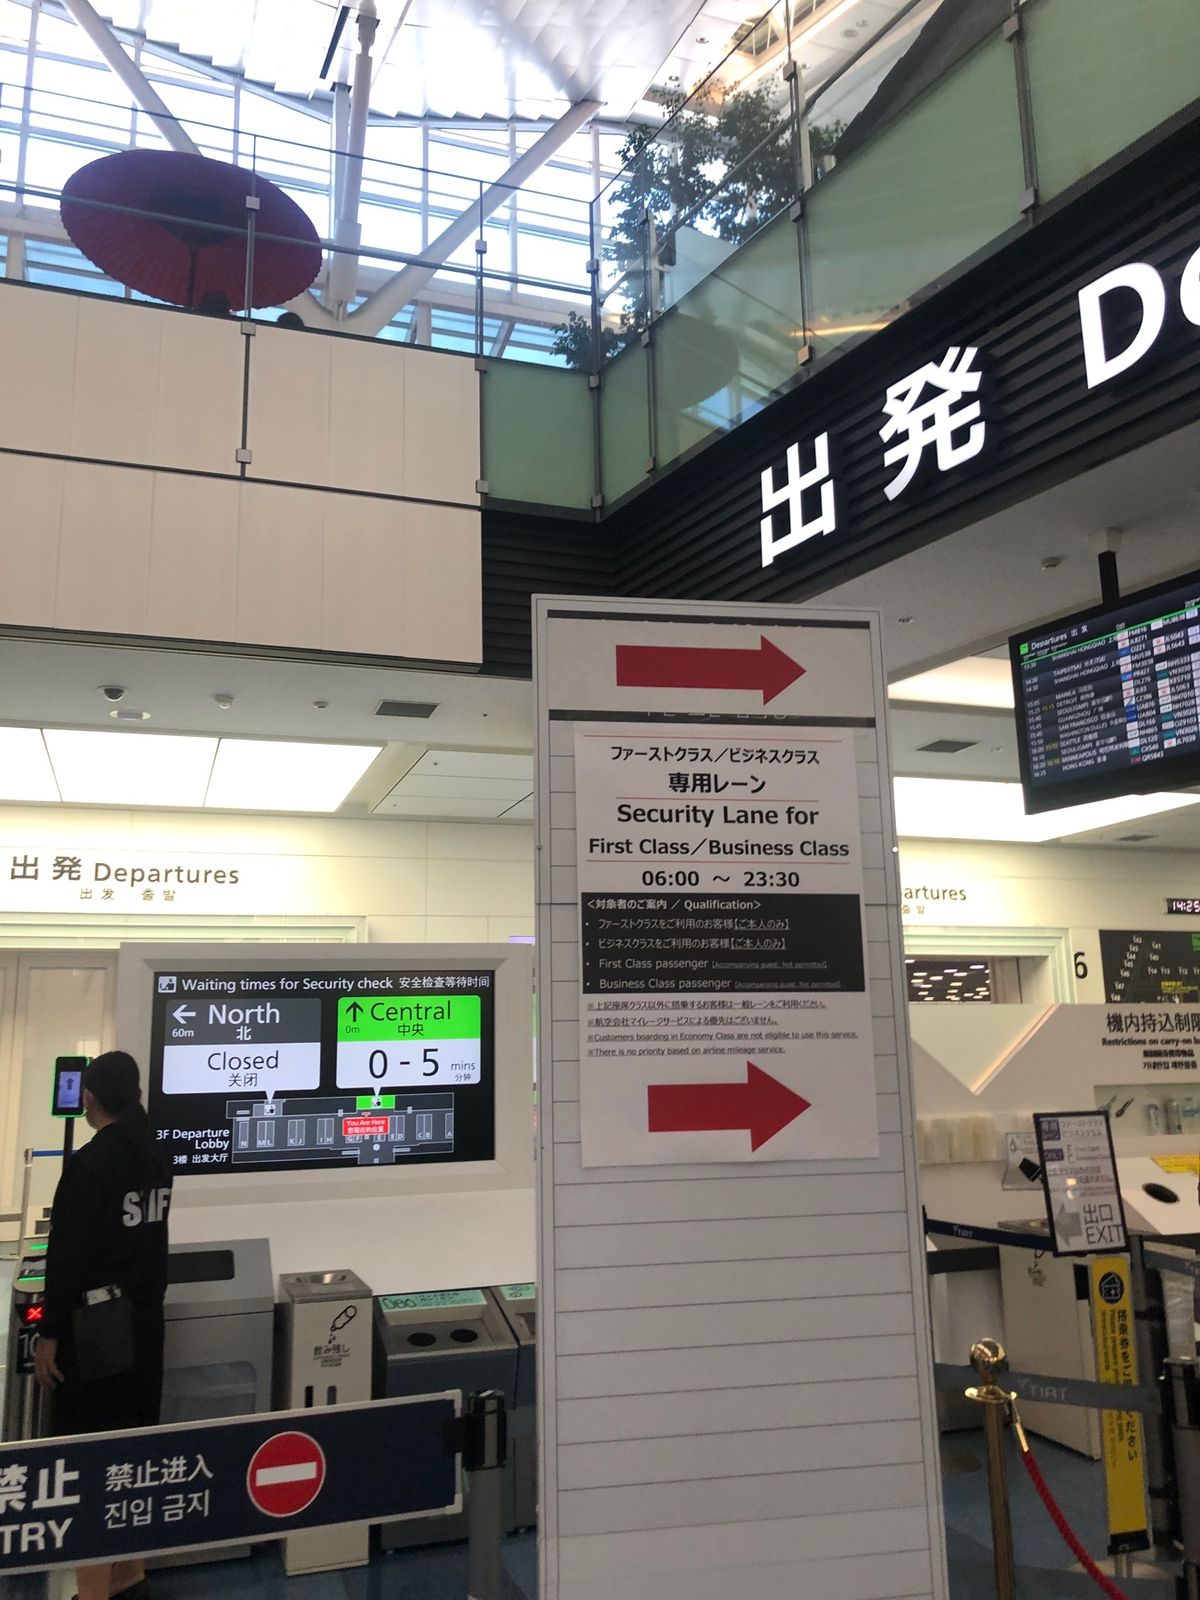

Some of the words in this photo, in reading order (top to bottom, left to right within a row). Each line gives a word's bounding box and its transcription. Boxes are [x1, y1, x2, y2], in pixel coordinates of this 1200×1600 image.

[1078, 245, 1200, 390] D
[760, 347, 986, 568] 出発
[1030, 633, 1067, 649] Departures
[611, 746, 820, 764] ファーストクラス／ビジネスクラス
[668, 772, 766, 793] 専用レーン
[617, 804, 714, 827] Security
[723, 806, 778, 825] Lane
[786, 806, 819, 825] for
[589, 838, 633, 854] First
[800, 841, 849, 856] Class
[10, 855, 82, 881] 出発
[94, 863, 239, 887] Departures
[642, 871, 699, 887] 06:00
[743, 872, 800, 888] 23:30
[599, 959, 622, 969] First
[625, 959, 652, 969] Class
[656, 959, 708, 971] passenger
[182, 979, 236, 993] Waiting
[241, 978, 276, 990] times
[279, 977, 300, 990] for
[303, 977, 354, 991] Security
[358, 976, 393, 989] check
[398, 976, 491, 989] 安全检查等待时间
[599, 979, 645, 989] Business
[648, 979, 676, 988] Class
[679, 979, 731, 990] passenger
[208, 1003, 281, 1026] North
[370, 1000, 452, 1022] Central
[171, 1027, 195, 1039] 60m
[236, 1026, 252, 1041] 北
[345, 1025, 361, 1034] 0m
[397, 1023, 425, 1037] 中央
[636, 1031, 668, 1042] boarding
[671, 1032, 678, 1040] in
[680, 1032, 713, 1041] Economy
[715, 1031, 735, 1039] Class
[765, 1031, 790, 1040] eligible
[816, 1031, 829, 1039] this
[1102, 1037, 1147, 1047] Restrictions
[1161, 1038, 1192, 1048] carry-on
[639, 1047, 664, 1057] priority
[667, 1047, 688, 1055] based
[727, 1046, 756, 1055] mileage
[758, 1046, 785, 1054] service.
[207, 1051, 280, 1071] Closed
[368, 1049, 389, 1079] 0
[421, 1048, 440, 1076] 5
[450, 1060, 476, 1072] mins
[228, 1073, 259, 1087] 关闭
[454, 1072, 473, 1082] 分钟
[360, 1118, 371, 1126] Are
[371, 1118, 386, 1126] Here
[156, 1129, 169, 1140] 3F
[172, 1127, 230, 1142] Departure
[195, 1138, 230, 1152] Lobby
[192, 1153, 229, 1164] 出发大厅
[1083, 1204, 1113, 1225] 出口
[1086, 1224, 1126, 1244] EXIT
[105, 1453, 214, 1493] 禁止进入
[105, 1500, 152, 1530] 진입
[162, 1490, 209, 1522] 금지
